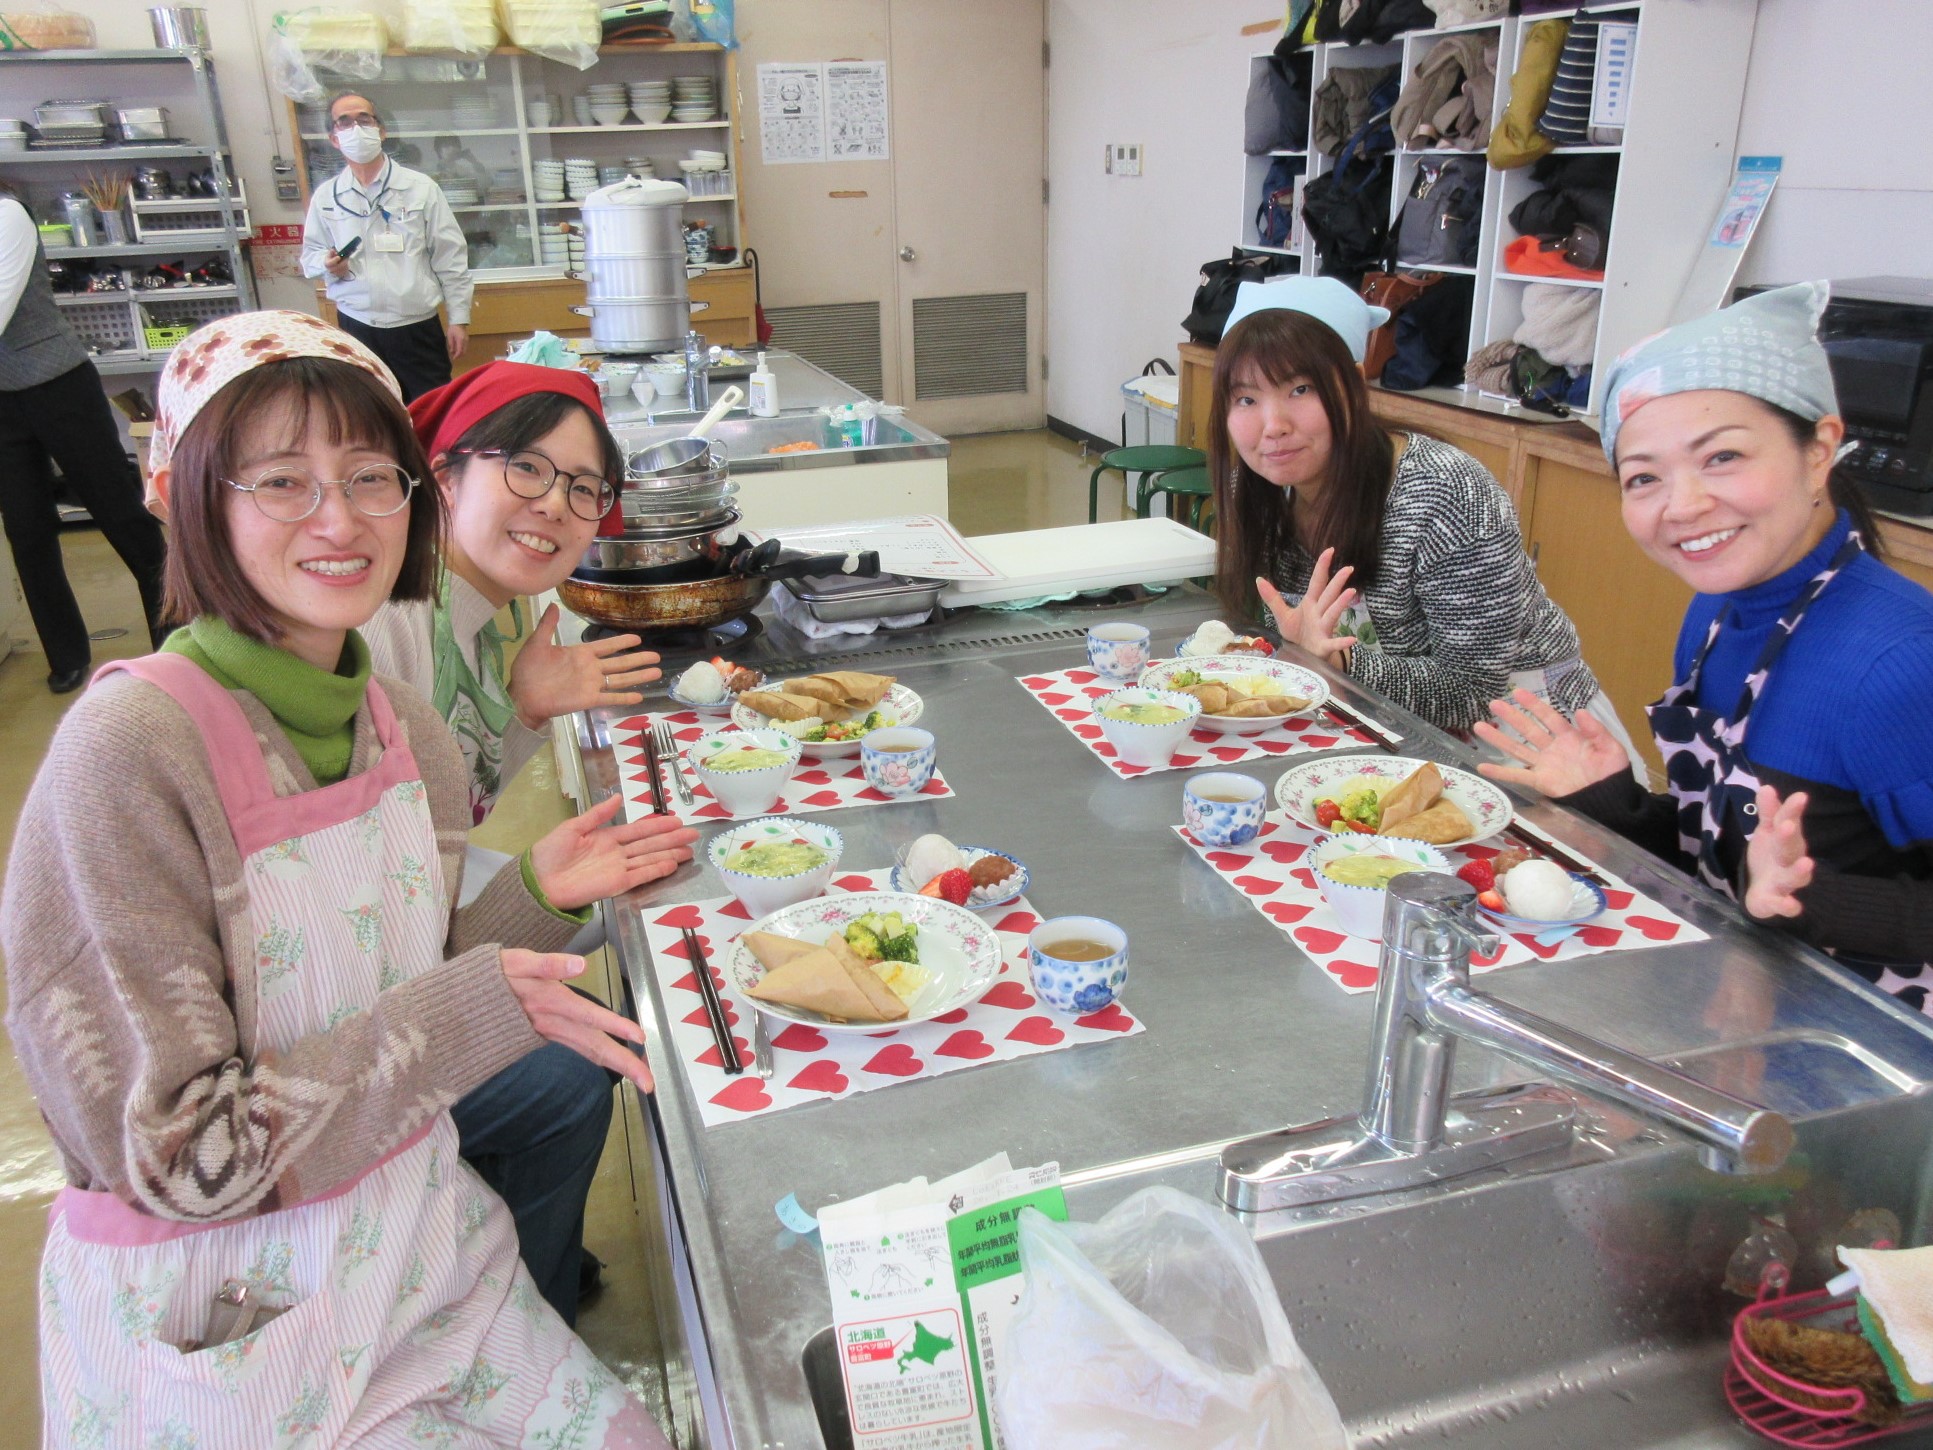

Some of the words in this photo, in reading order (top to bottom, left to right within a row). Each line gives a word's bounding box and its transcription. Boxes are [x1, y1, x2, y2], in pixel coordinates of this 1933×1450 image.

[976, 1204, 1035, 1232] 成分無調
[958, 1232, 1019, 1260] 年間平均無脂乳
[847, 1327, 886, 1343] 北海道
[977, 1312, 995, 1371] 成分無調整
